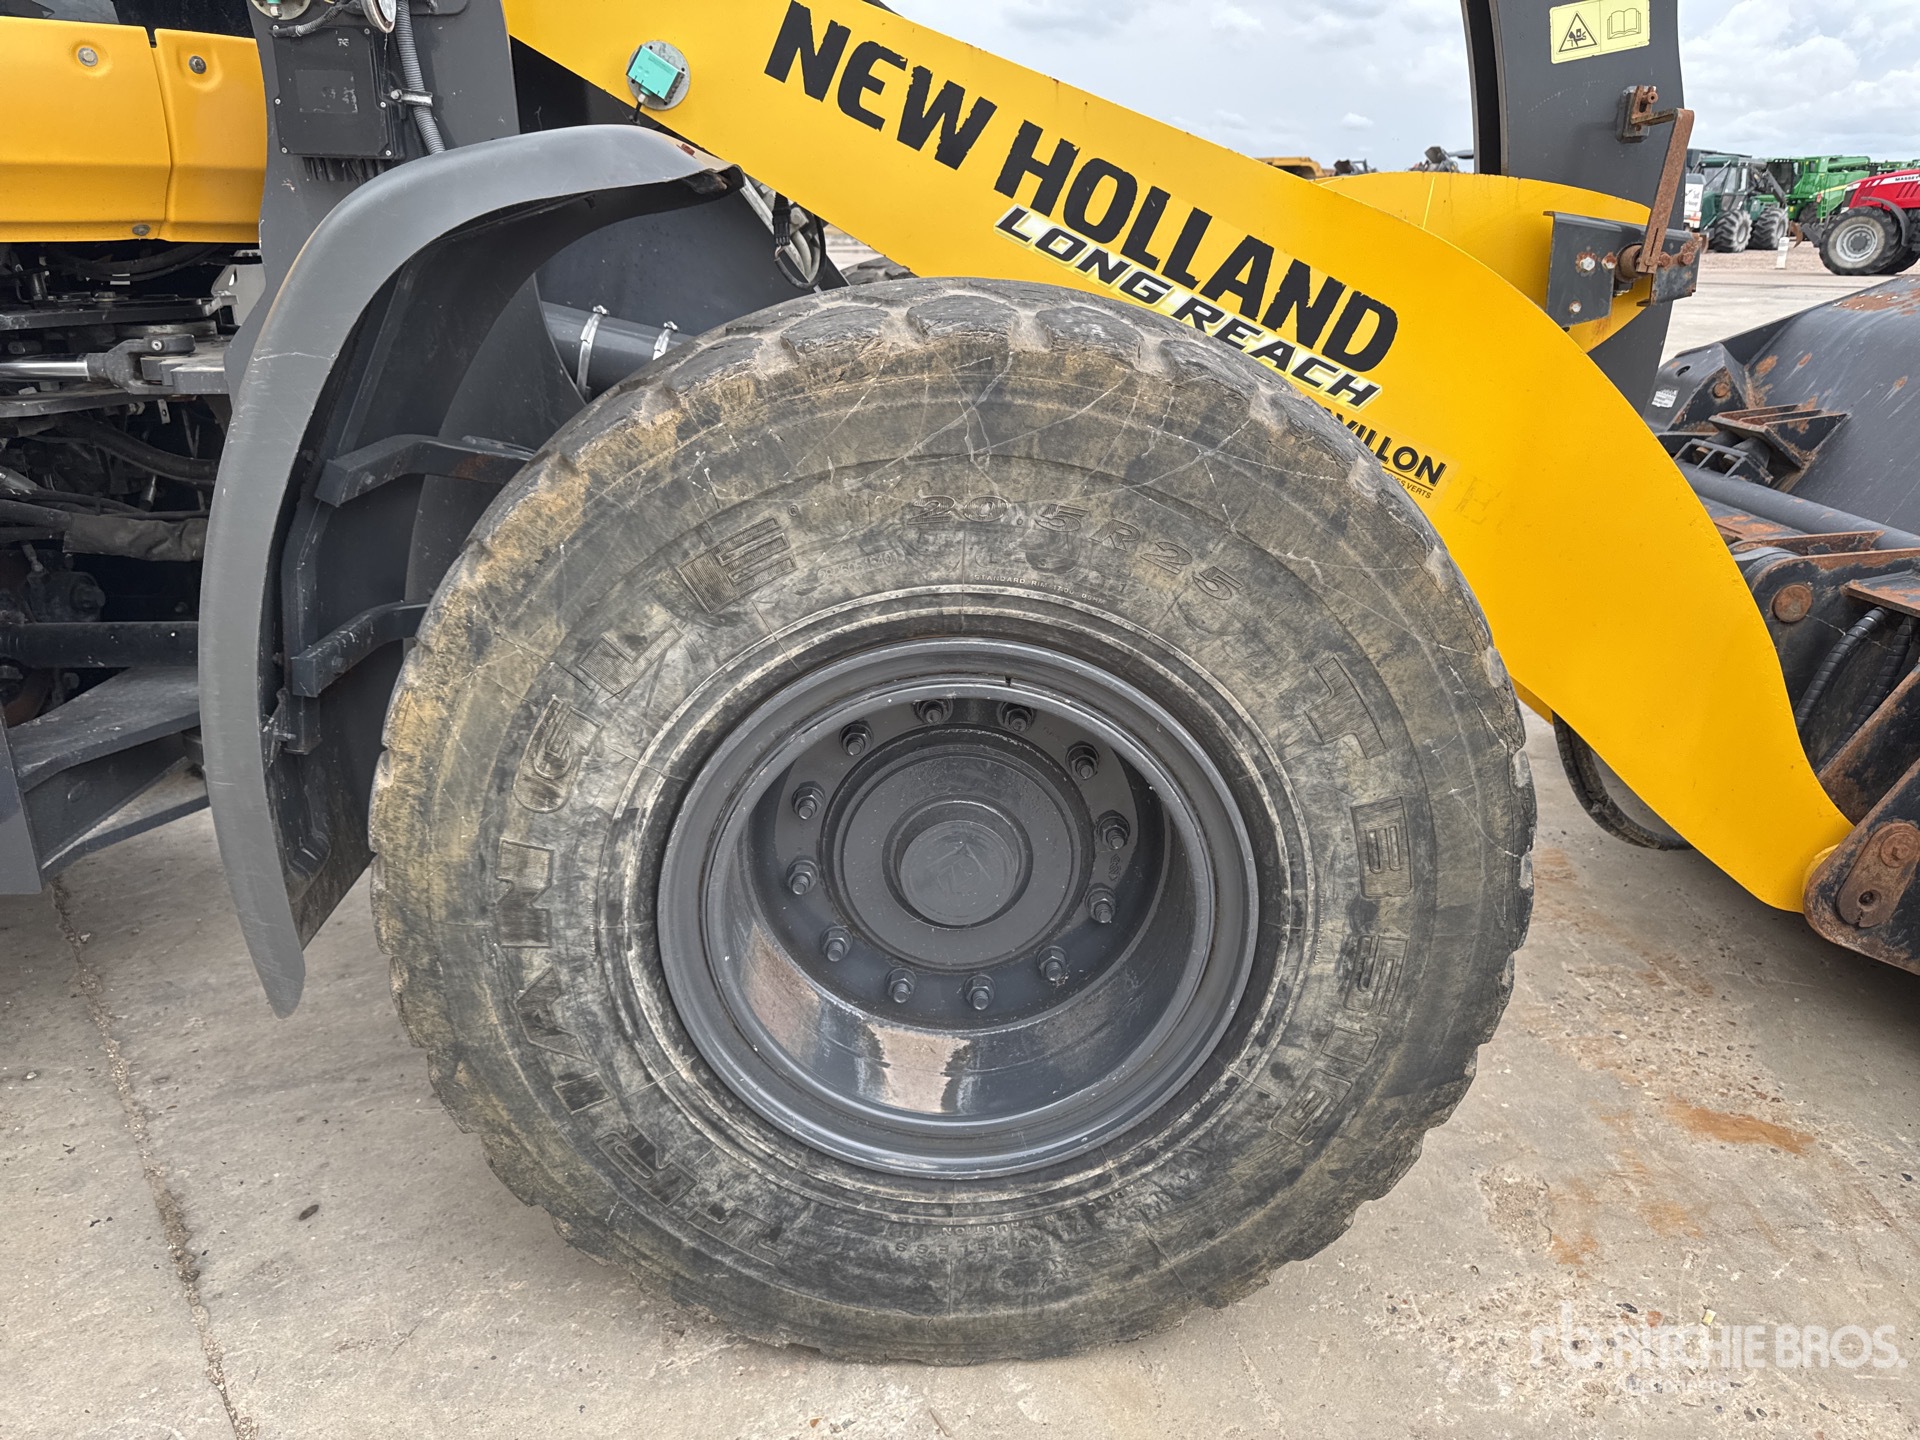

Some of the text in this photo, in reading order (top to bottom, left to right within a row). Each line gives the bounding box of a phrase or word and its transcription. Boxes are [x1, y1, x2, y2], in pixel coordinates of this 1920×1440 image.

[764, 0, 1399, 373] NEW HOLLAND
[994, 204, 1381, 408] LONG REACH
